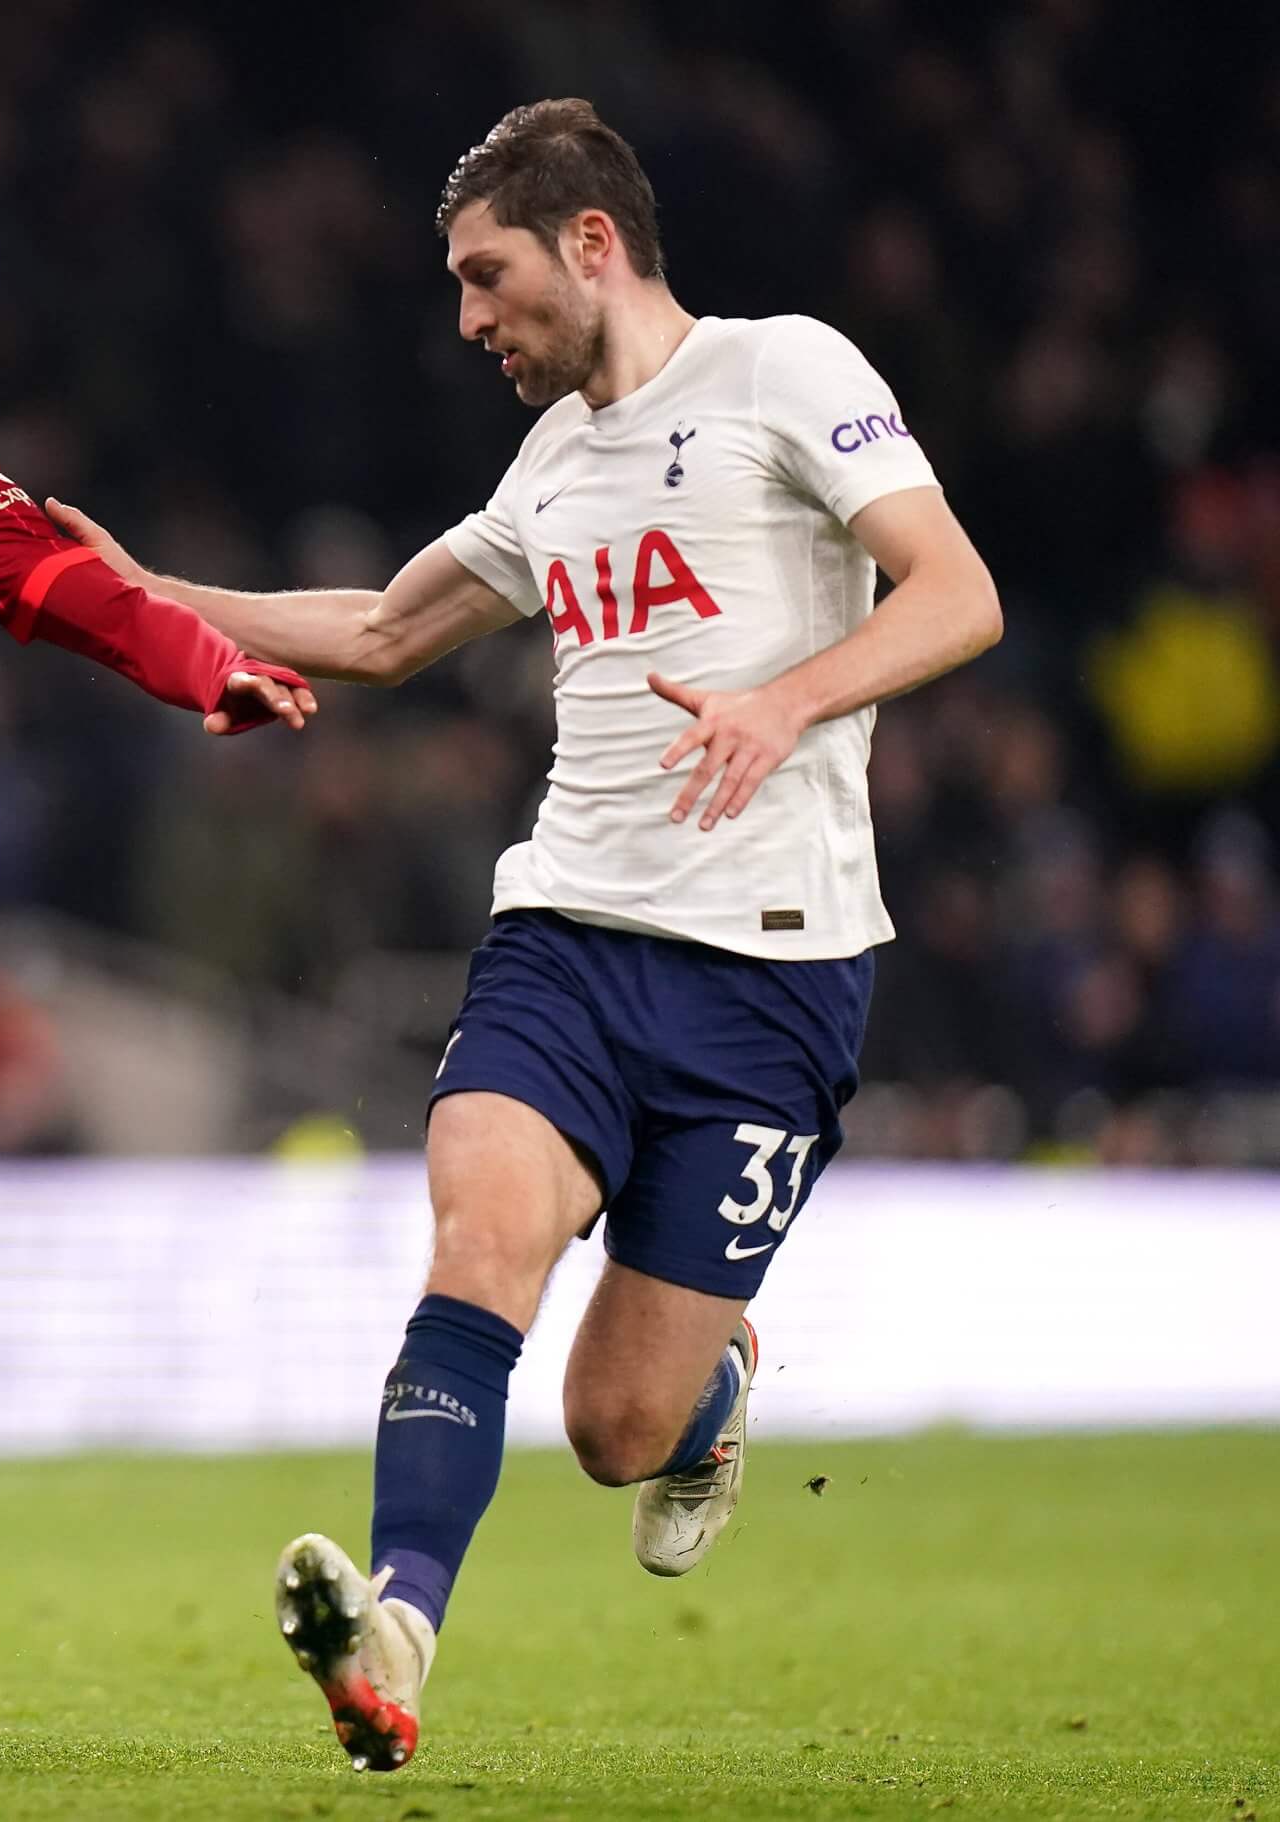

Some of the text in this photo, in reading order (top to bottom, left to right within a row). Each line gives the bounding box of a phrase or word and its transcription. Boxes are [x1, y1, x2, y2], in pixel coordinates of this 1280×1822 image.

[546, 528, 723, 655] AIA
[717, 1122, 820, 1233] 33
[382, 1383, 478, 1428] SPURS
